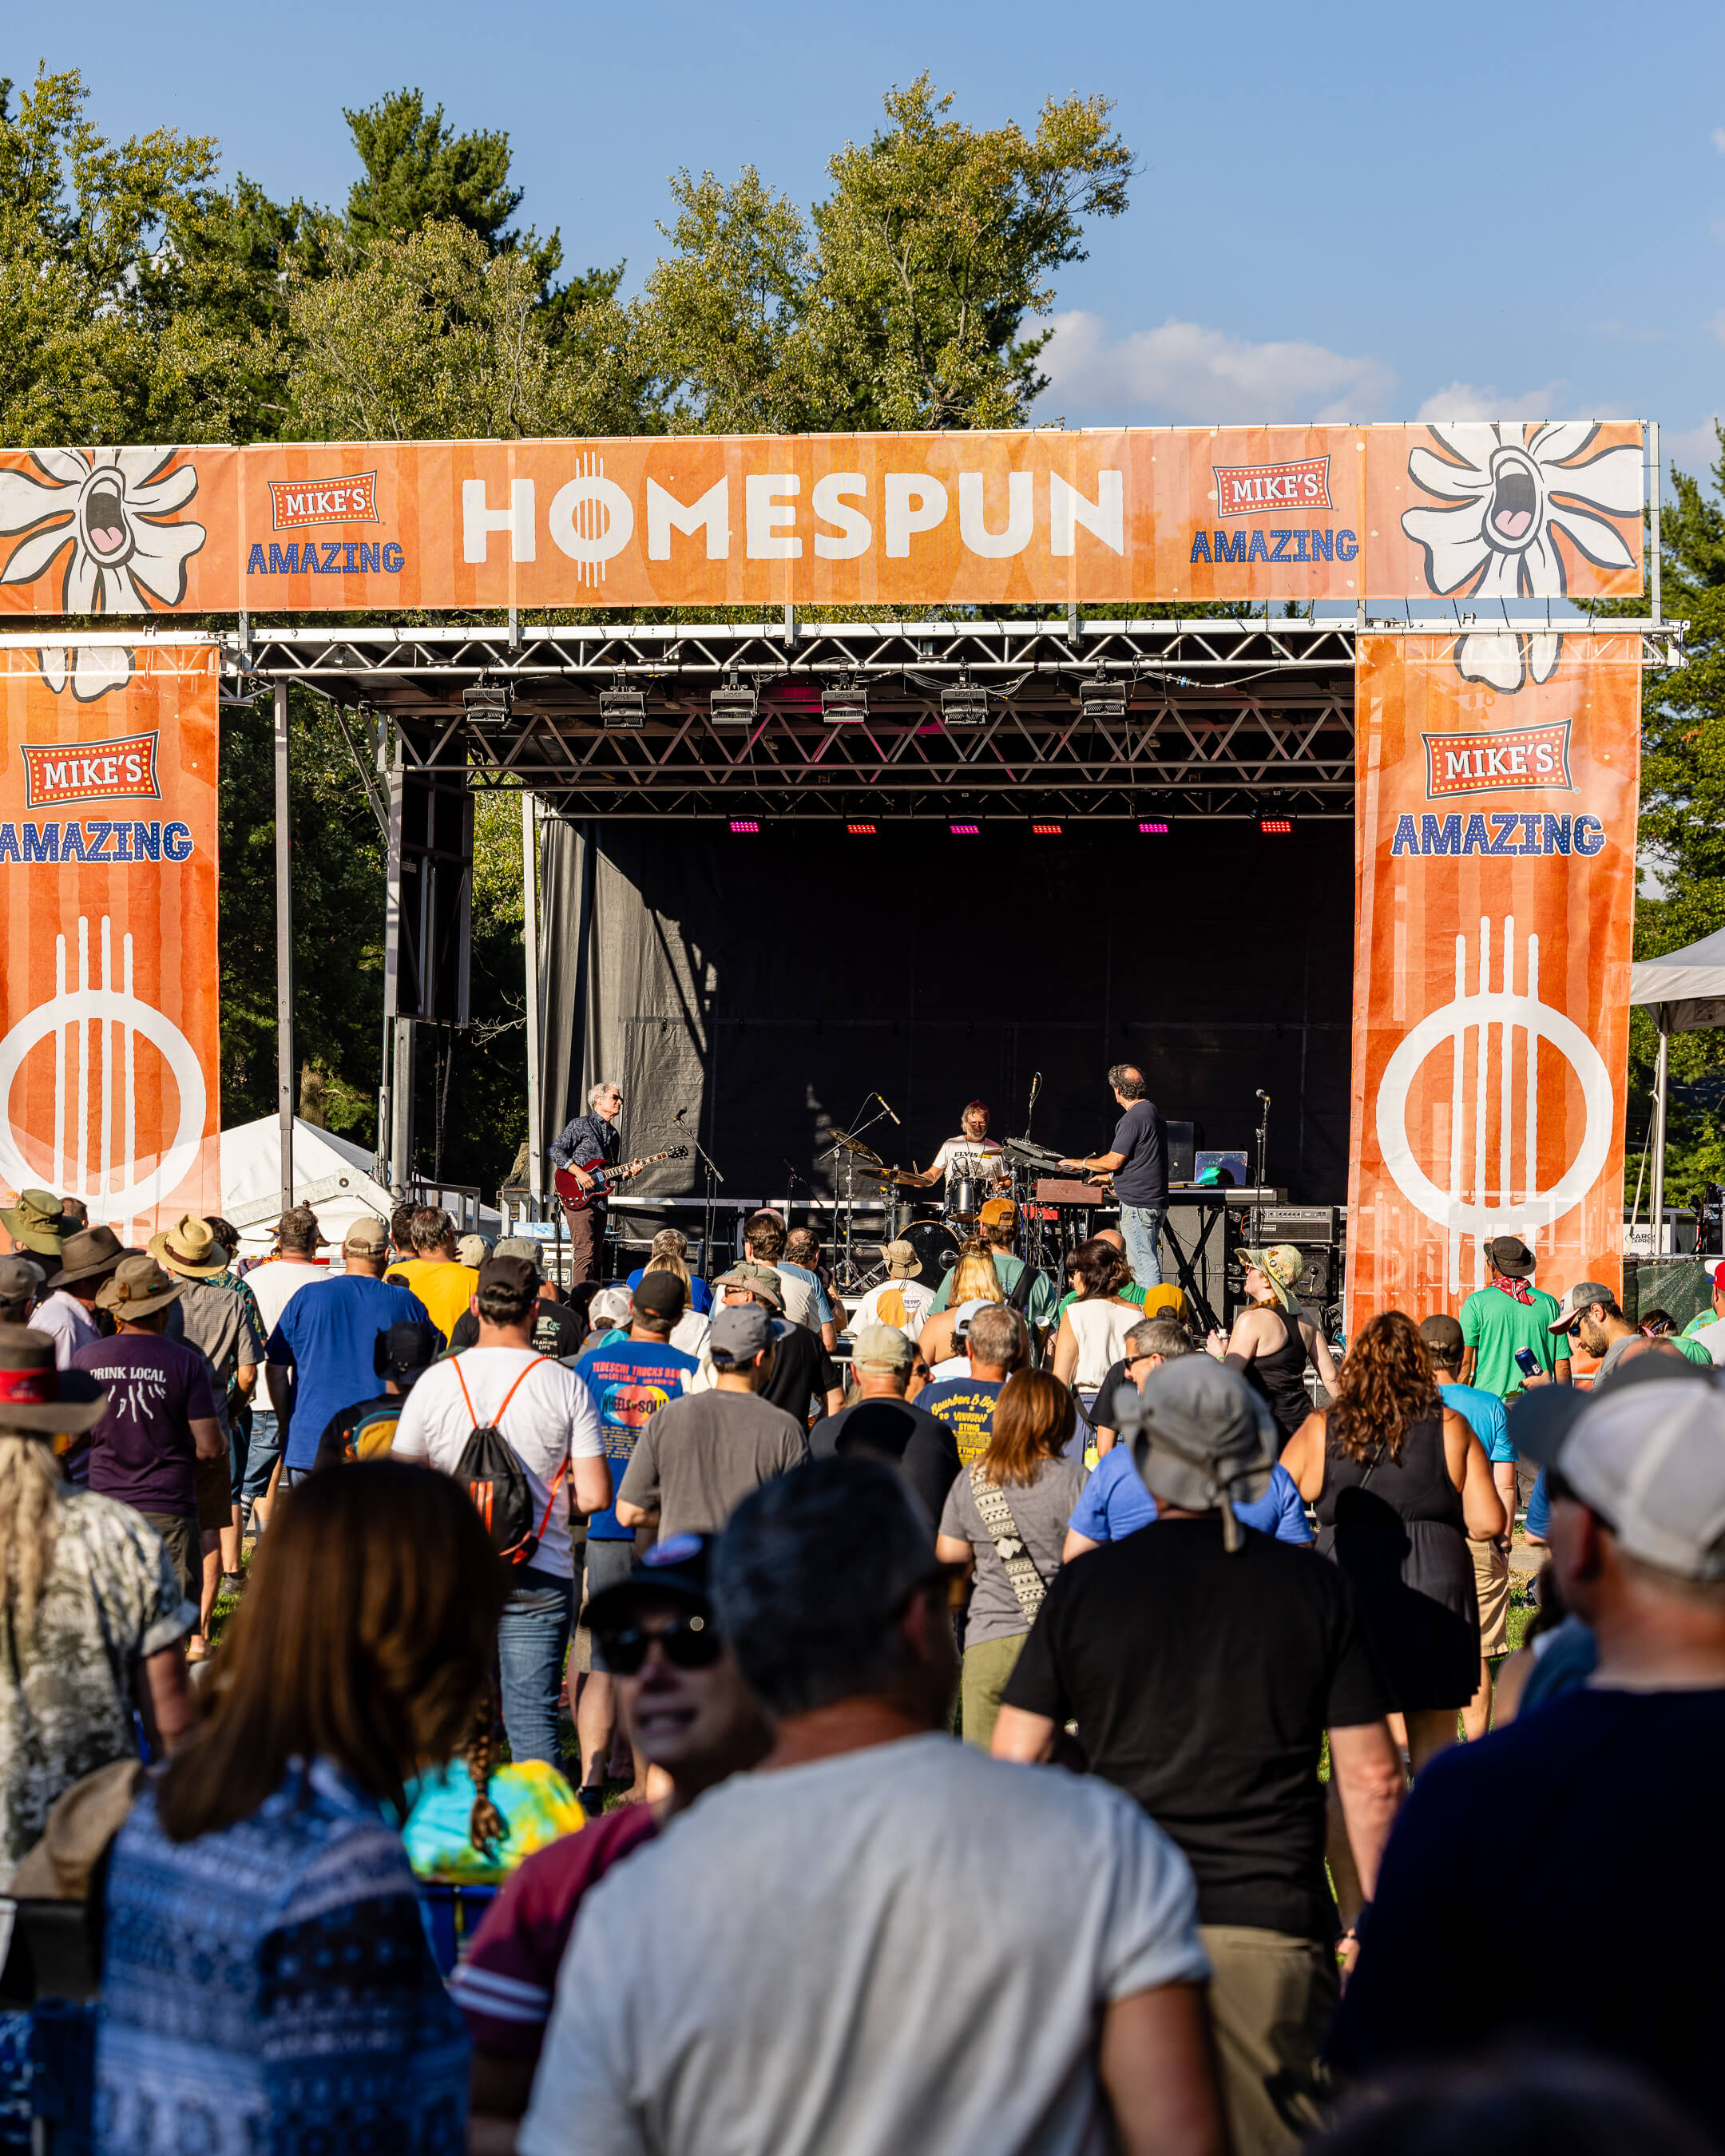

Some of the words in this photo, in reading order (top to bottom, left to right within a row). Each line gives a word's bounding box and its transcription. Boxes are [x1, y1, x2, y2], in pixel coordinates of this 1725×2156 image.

[285, 487, 367, 517] MIKE'S
[1231, 474, 1320, 503] MIKE'S
[462, 462, 1124, 577] HOMESPUN
[246, 541, 406, 575] AMAZING
[1189, 529, 1359, 564] AMAZING
[42, 753, 142, 791] MIKE'S
[1443, 743, 1555, 780] MIKE'S
[0, 821, 193, 863] AMAZING
[1390, 812, 1606, 858] AMAZING
[130, 1366, 166, 1383] LOCAL
[592, 1361, 630, 1374] TEDESCHI
[632, 1365, 664, 1377] TRUCKS
[601, 1392, 630, 1413] WHEELS
